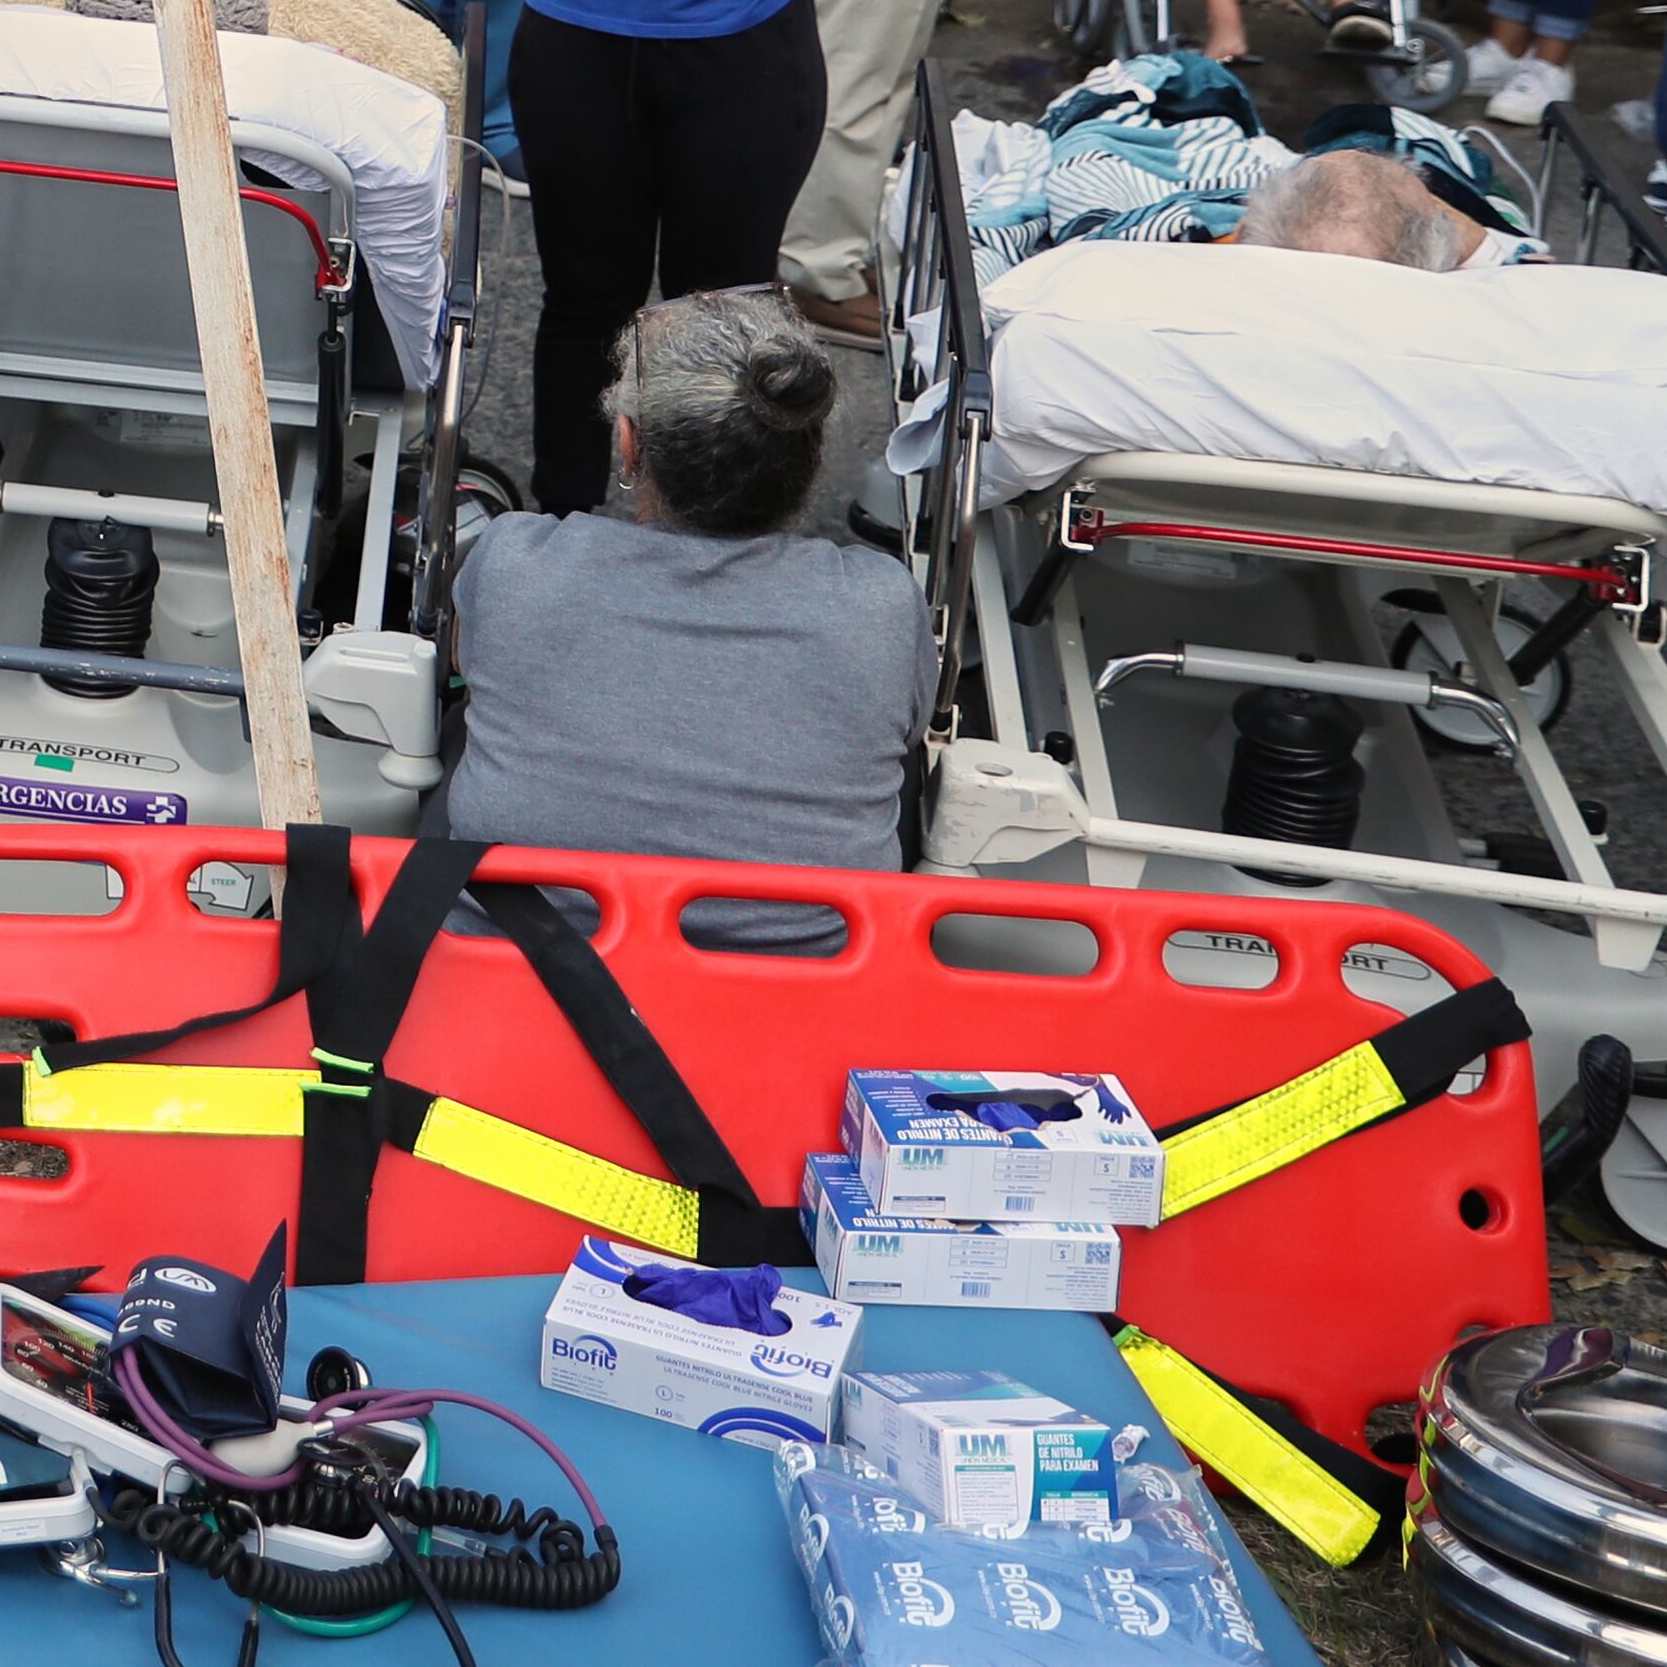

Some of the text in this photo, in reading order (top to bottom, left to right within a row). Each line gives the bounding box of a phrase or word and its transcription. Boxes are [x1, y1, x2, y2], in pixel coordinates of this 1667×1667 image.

[210, 877, 237, 887] STEER
[909, 1118, 959, 1130] EXAMEN
[897, 1127, 942, 1141] NITRILO
[943, 1127, 957, 1141] DE
[901, 1148, 945, 1166] UM
[1103, 1162, 1111, 1174] S
[852, 1217, 898, 1228] NITRILO
[857, 1234, 901, 1252] UM
[1059, 1249, 1067, 1260] S
[634, 1312, 657, 1327] BLUE
[657, 1317, 680, 1332] COOL
[561, 1305, 743, 1357] GUANTES NITRILO ULTRASENSE COOL BLUE
[551, 1334, 618, 1371] Biofit
[749, 1342, 833, 1380] Biofit
[655, 1354, 814, 1404] GUANTES NITRILO ULTRASENSE COOL BLUE
[663, 1366, 814, 1413] ULTRASENSE COOL BLUE NITRILE GLOVES
[654, 1407, 673, 1418] 100
[958, 1434, 1007, 1456] UM
[1037, 1433, 1075, 1446] GUANTES
[1038, 1446, 1083, 1460] DE NITRILO
[1039, 1460, 1100, 1473] PARA EXAMEN
[892, 1561, 941, 1627] Biofit
[997, 1562, 1044, 1630] Biofit
[1103, 1566, 1151, 1636] Biofit
[1208, 1573, 1265, 1653] Biofit
